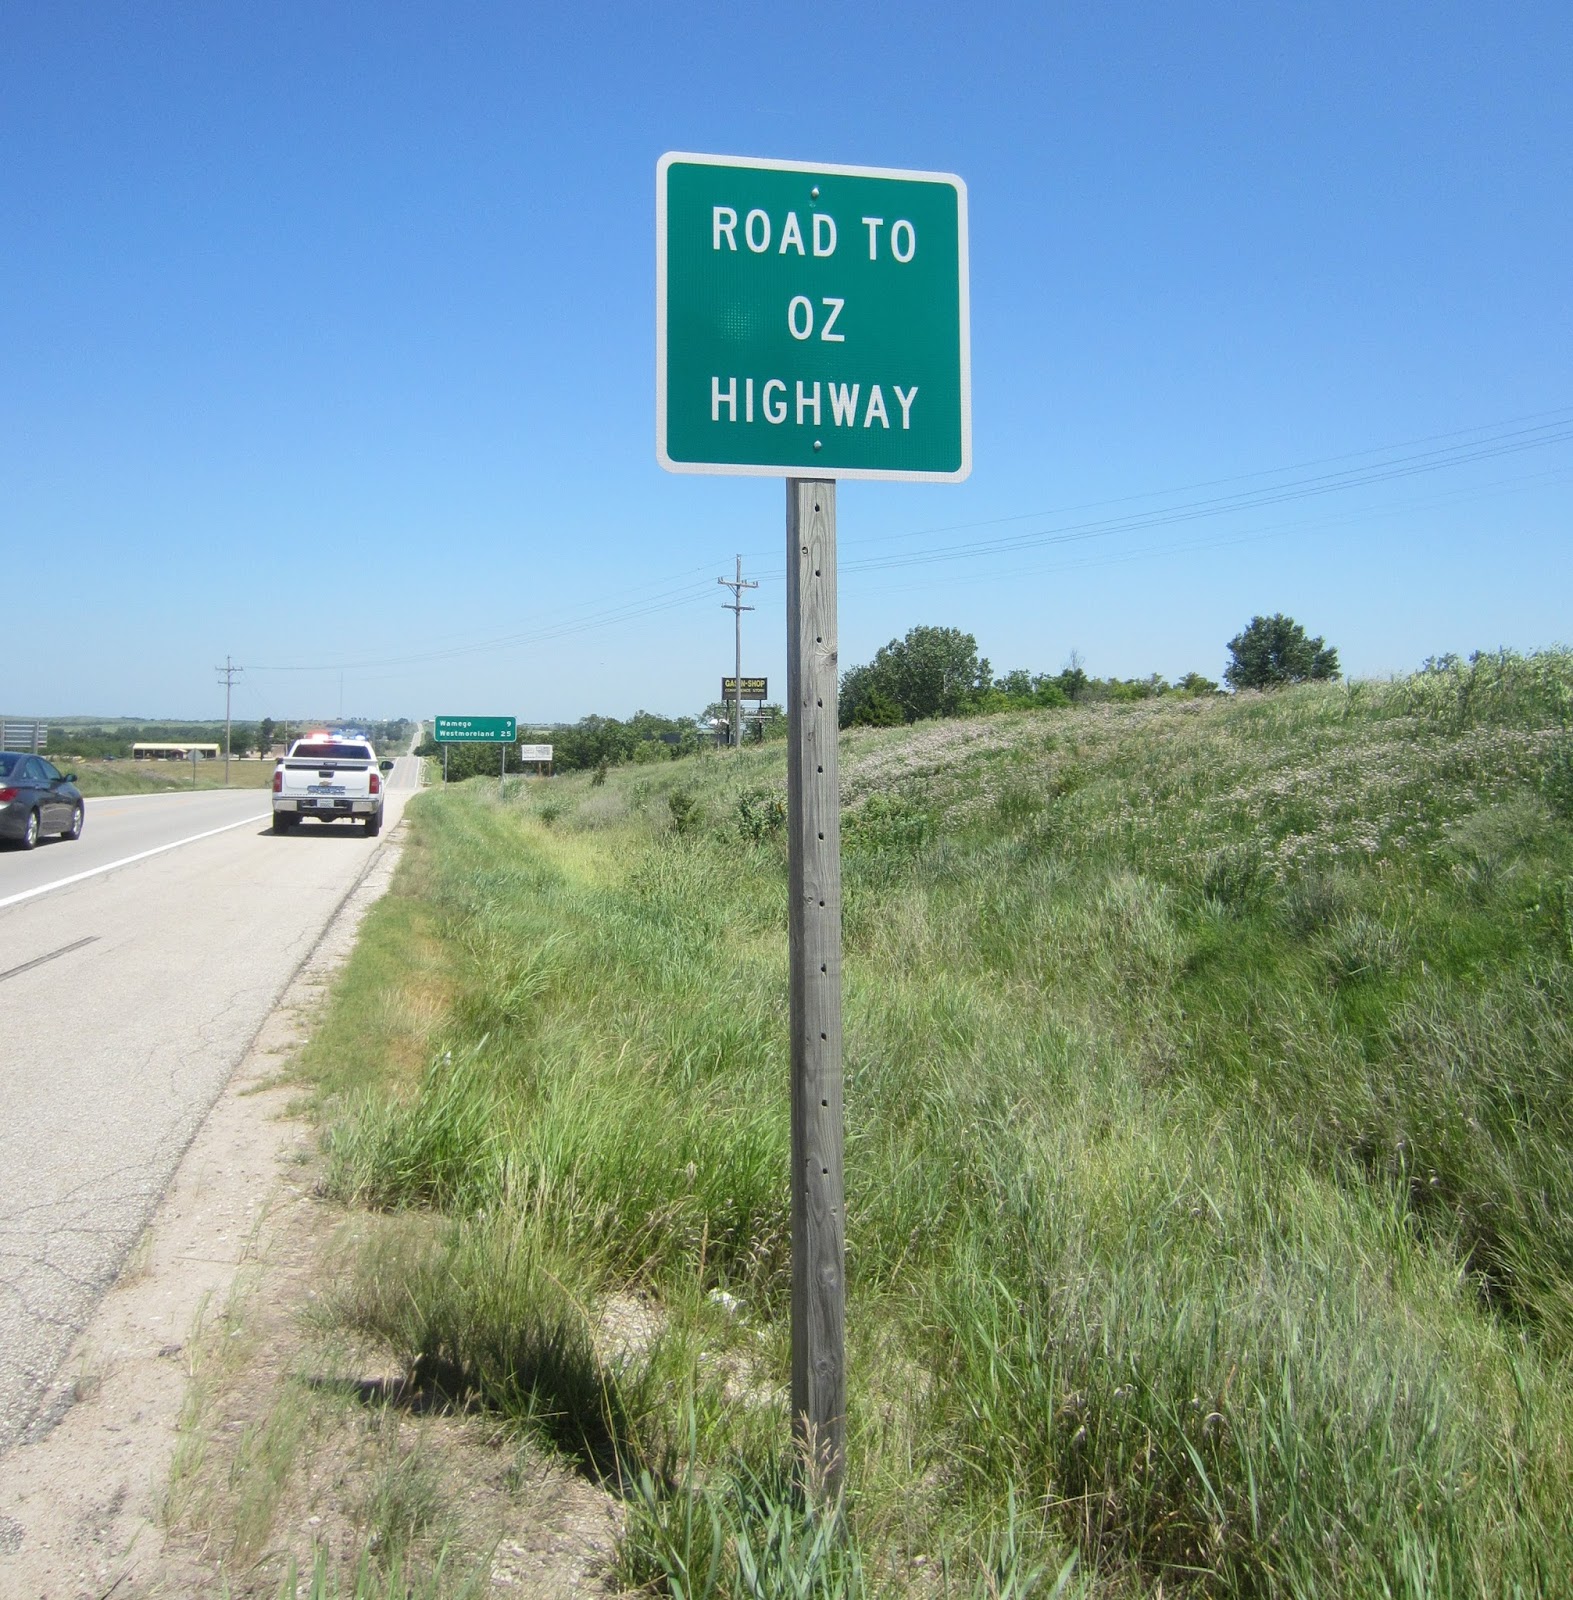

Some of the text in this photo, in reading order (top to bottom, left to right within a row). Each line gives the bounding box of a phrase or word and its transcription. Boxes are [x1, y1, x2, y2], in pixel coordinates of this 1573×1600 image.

[712, 206, 916, 263] ROAD TO
[787, 295, 845, 342] OZ
[711, 376, 919, 430] HIGHWAY
[440, 720, 512, 729] Wamego 9
